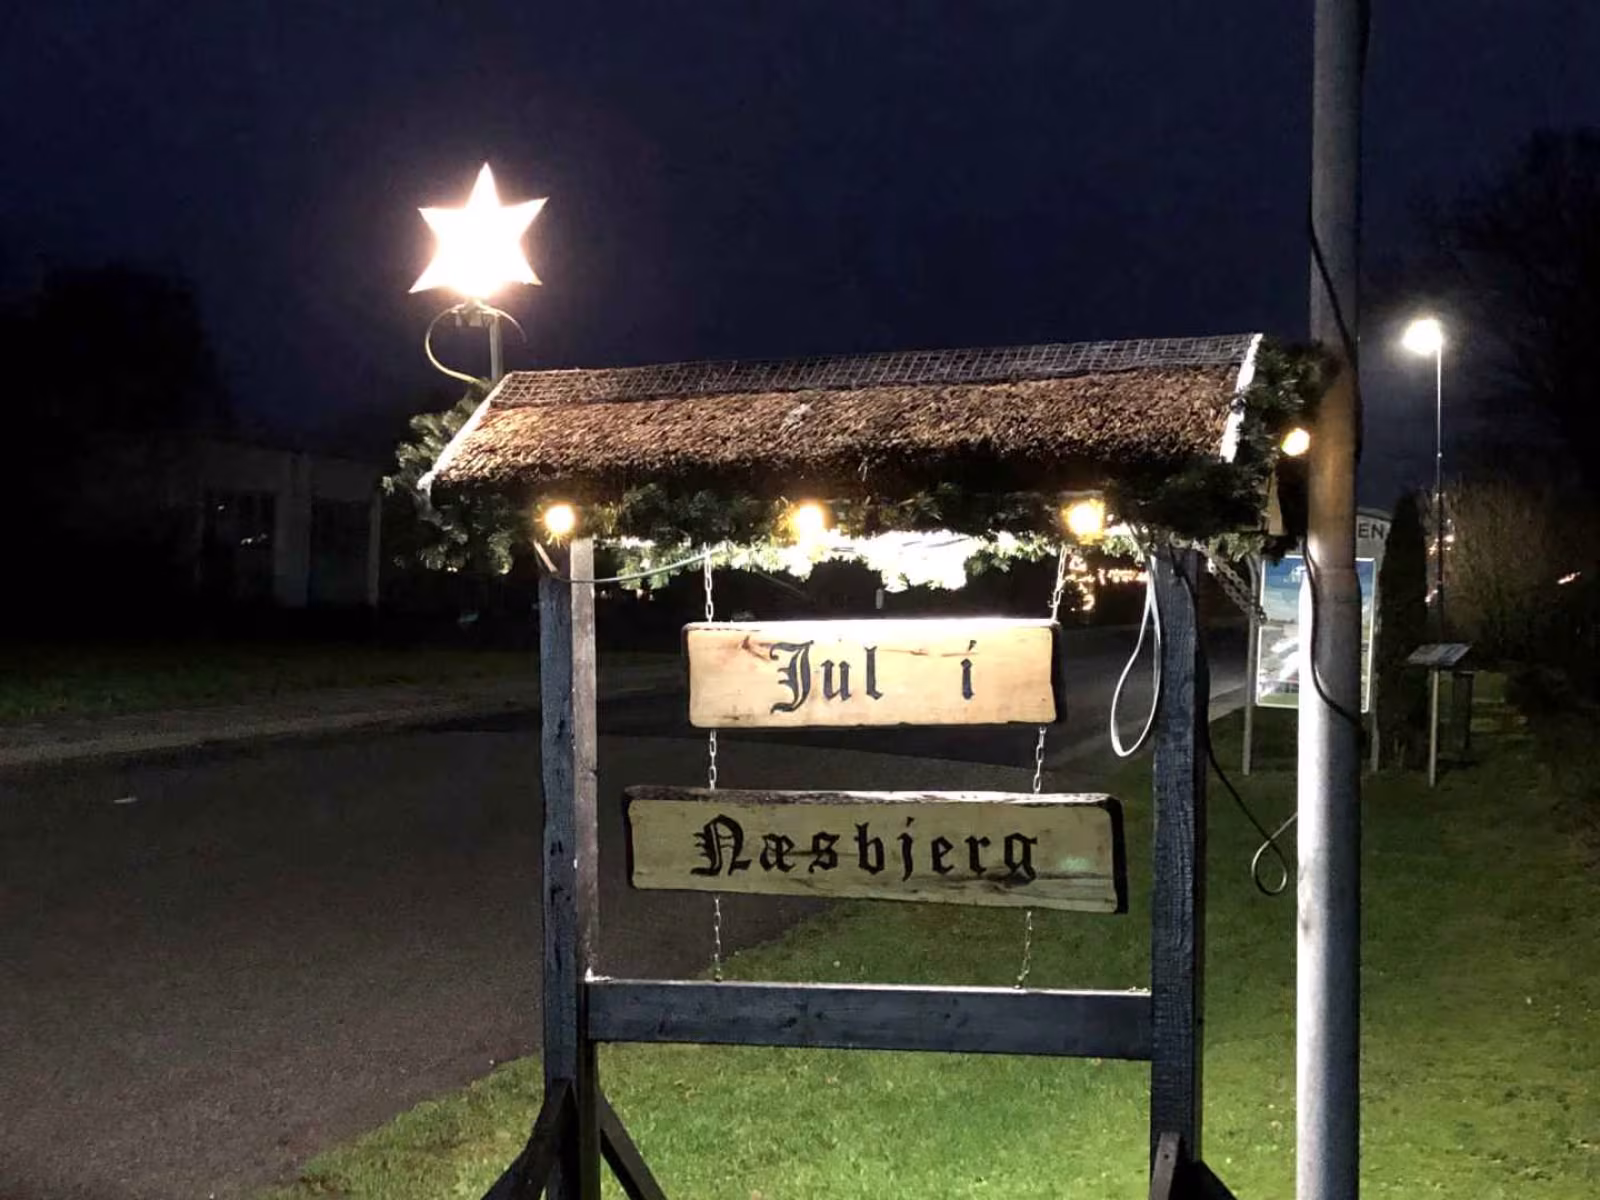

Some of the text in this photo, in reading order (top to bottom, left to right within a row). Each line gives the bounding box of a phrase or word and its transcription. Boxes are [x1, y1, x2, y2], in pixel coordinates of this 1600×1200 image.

[770, 640, 977, 714] Jul i
[691, 813, 1038, 885] Næsbjerg
